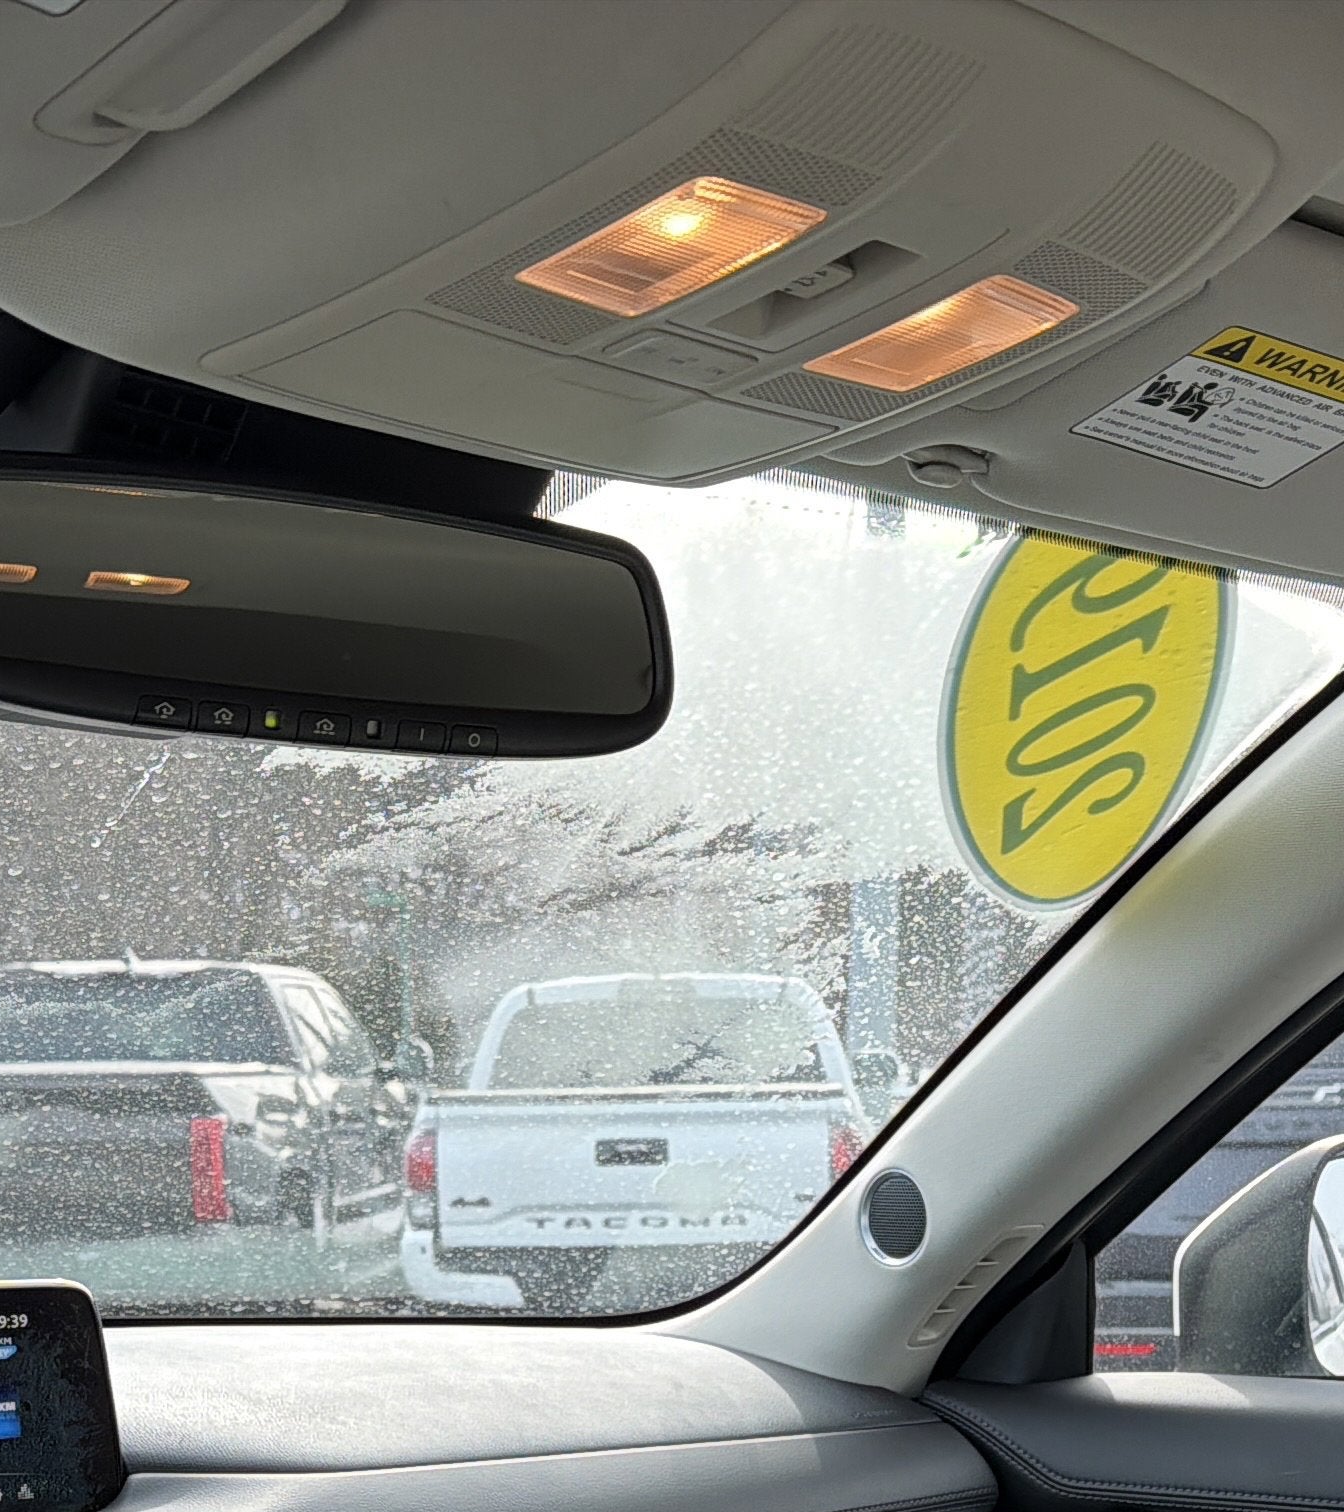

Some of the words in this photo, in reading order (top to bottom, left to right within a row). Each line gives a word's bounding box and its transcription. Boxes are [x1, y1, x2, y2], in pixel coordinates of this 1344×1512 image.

[1197, 365, 1227, 378] EVEN
[1228, 375, 1256, 387] WITH
[1257, 384, 1313, 404] ADVANCED
[1313, 402, 1333, 411] AIR
[527, 1214, 748, 1230] TACOMA
